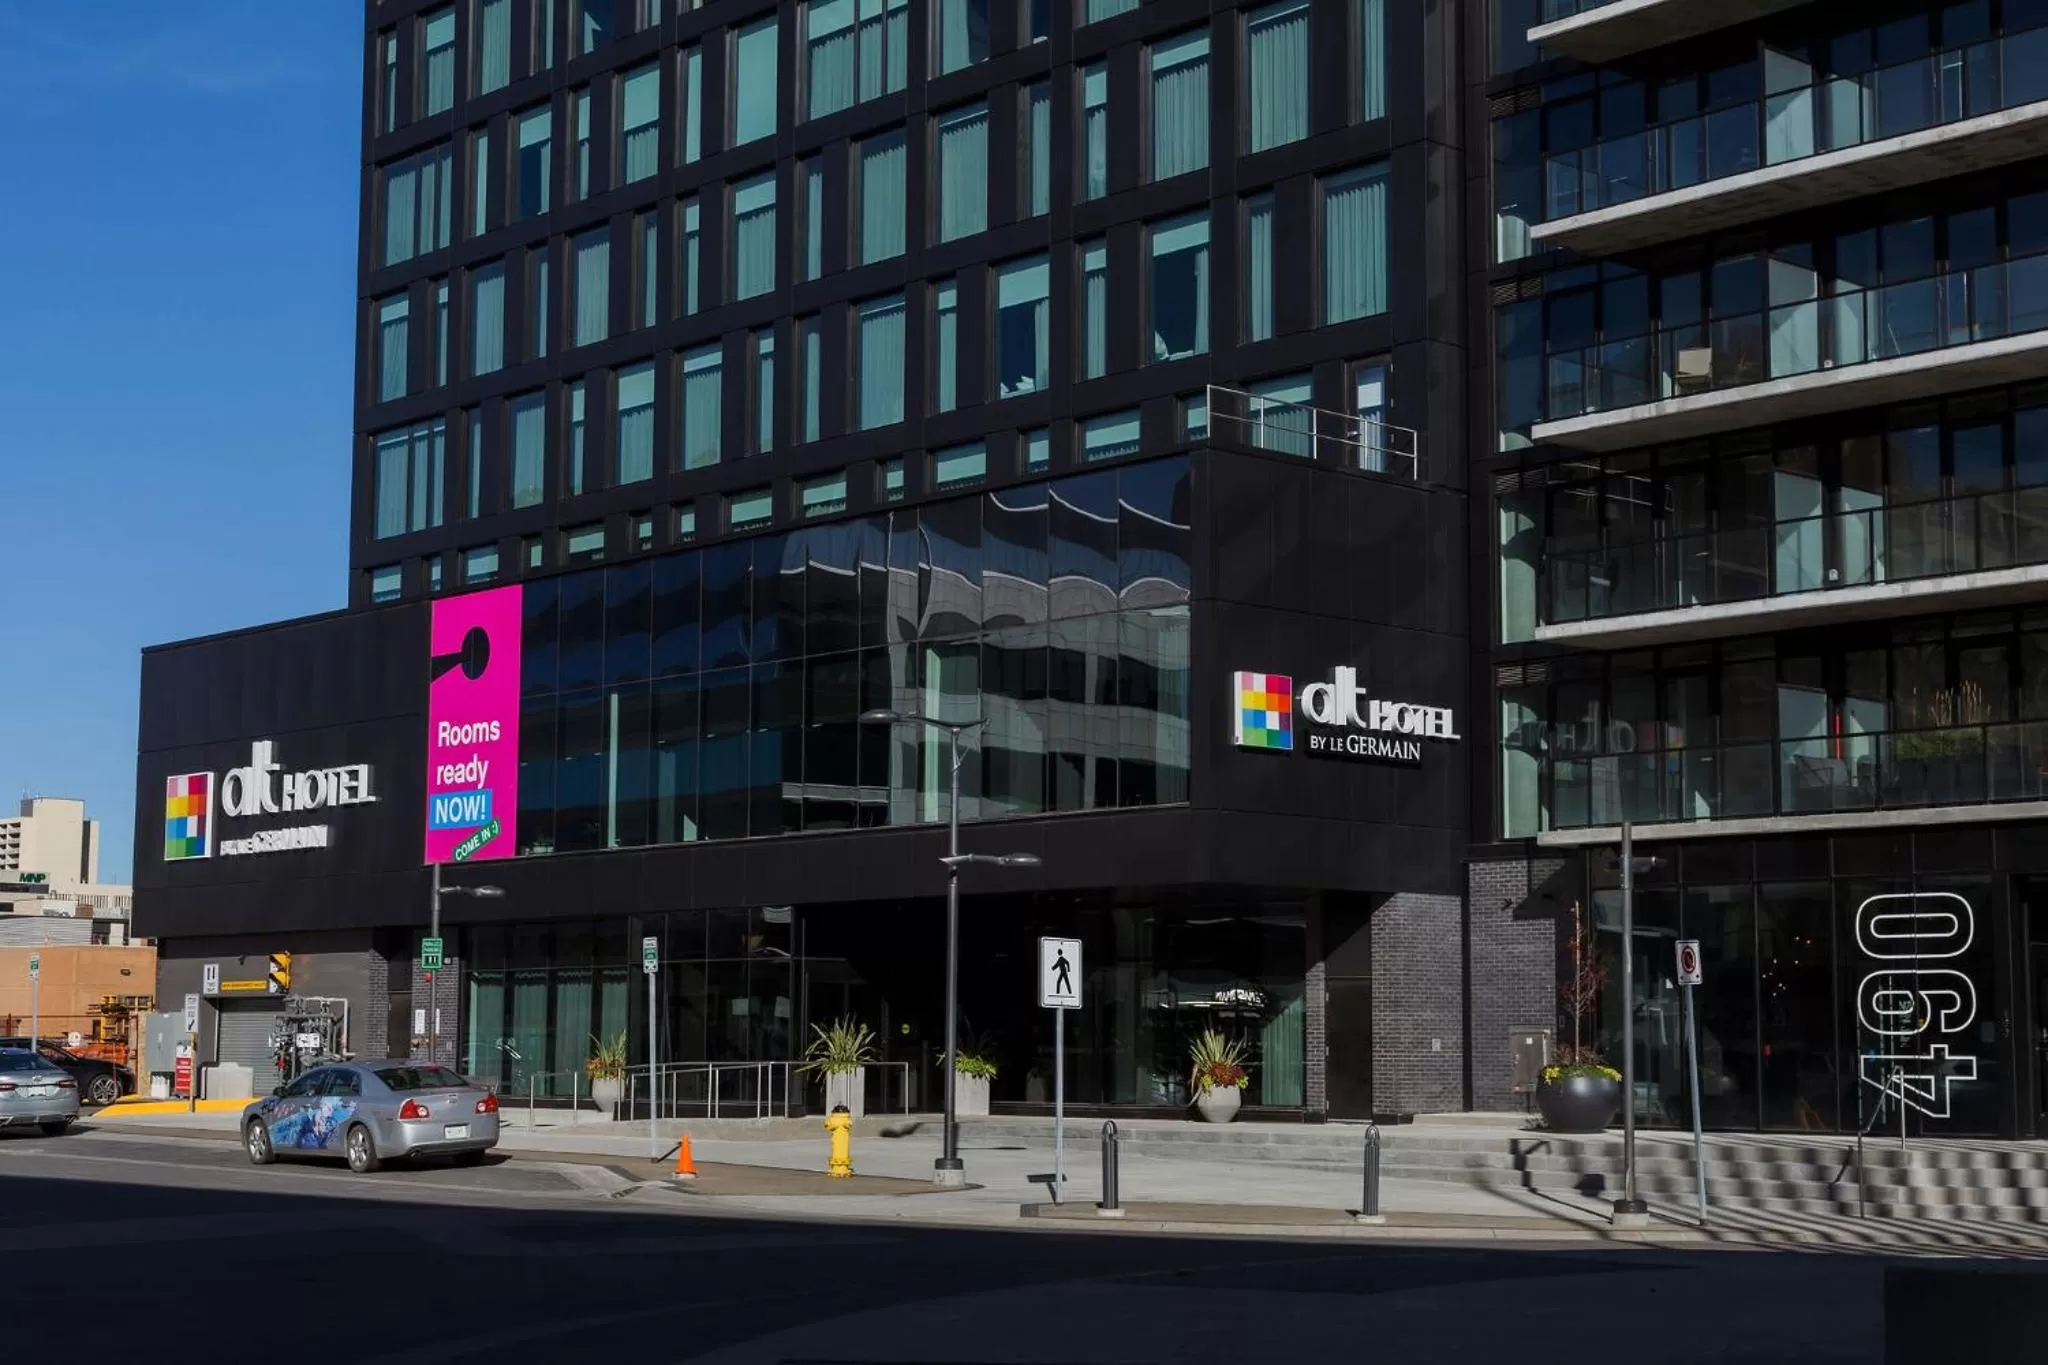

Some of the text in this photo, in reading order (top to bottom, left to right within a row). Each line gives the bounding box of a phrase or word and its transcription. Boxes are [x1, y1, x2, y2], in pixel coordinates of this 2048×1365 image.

[438, 720, 500, 748] Rooms
[1370, 699, 1461, 739] HOTEL
[1310, 735, 1421, 760] BY LE GERMAIN
[282, 764, 376, 811] HOTEL
[436, 753, 489, 789] ready
[435, 795, 486, 824] NOW!
[455, 834, 480, 860] COME
[481, 827, 491, 842] IN
[19, 873, 46, 883] MNP
[1856, 892, 1977, 1118] 490
